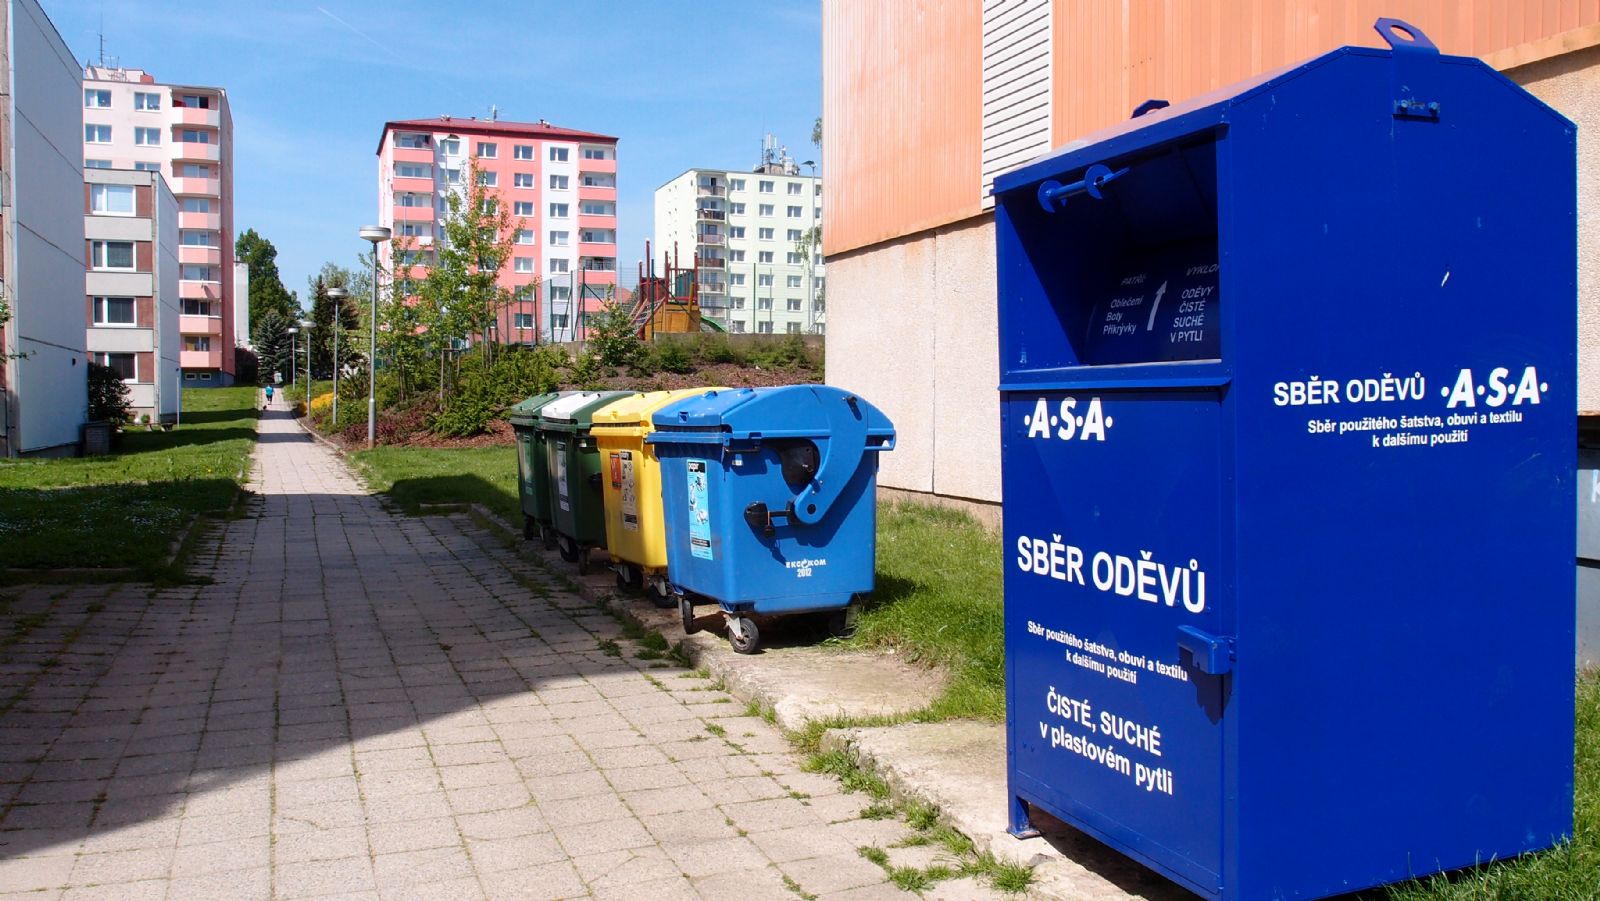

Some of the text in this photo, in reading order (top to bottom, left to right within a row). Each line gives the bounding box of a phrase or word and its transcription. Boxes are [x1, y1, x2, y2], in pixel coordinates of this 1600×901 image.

[1181, 285, 1214, 299] ODĚVY
[1179, 298, 1206, 313] ČISTÉ
[1106, 312, 1123, 323] Boty
[1173, 314, 1205, 328] SUCHÉ
[1170, 330, 1203, 343] V PYTLI
[1273, 375, 1340, 407] SBĚR
[1346, 371, 1425, 403] ODĚVŮ
[1308, 410, 1522, 434] Sběr použitého šatstva, obuvi a textilu
[1372, 428, 1468, 447] k dalšímu použití
[797, 567, 812, 578] 2012
[1017, 533, 1205, 613] SBĚR ODĚVŮ
[1027, 620, 1188, 681] Sběr použitého šatstva, obuvi a textilu
[1066, 649, 1137, 685] k dalšímu použití
[1046, 686, 1161, 756] ČISTÉ, SUCHÉ
[1039, 721, 1173, 795] v plastovém pytli
